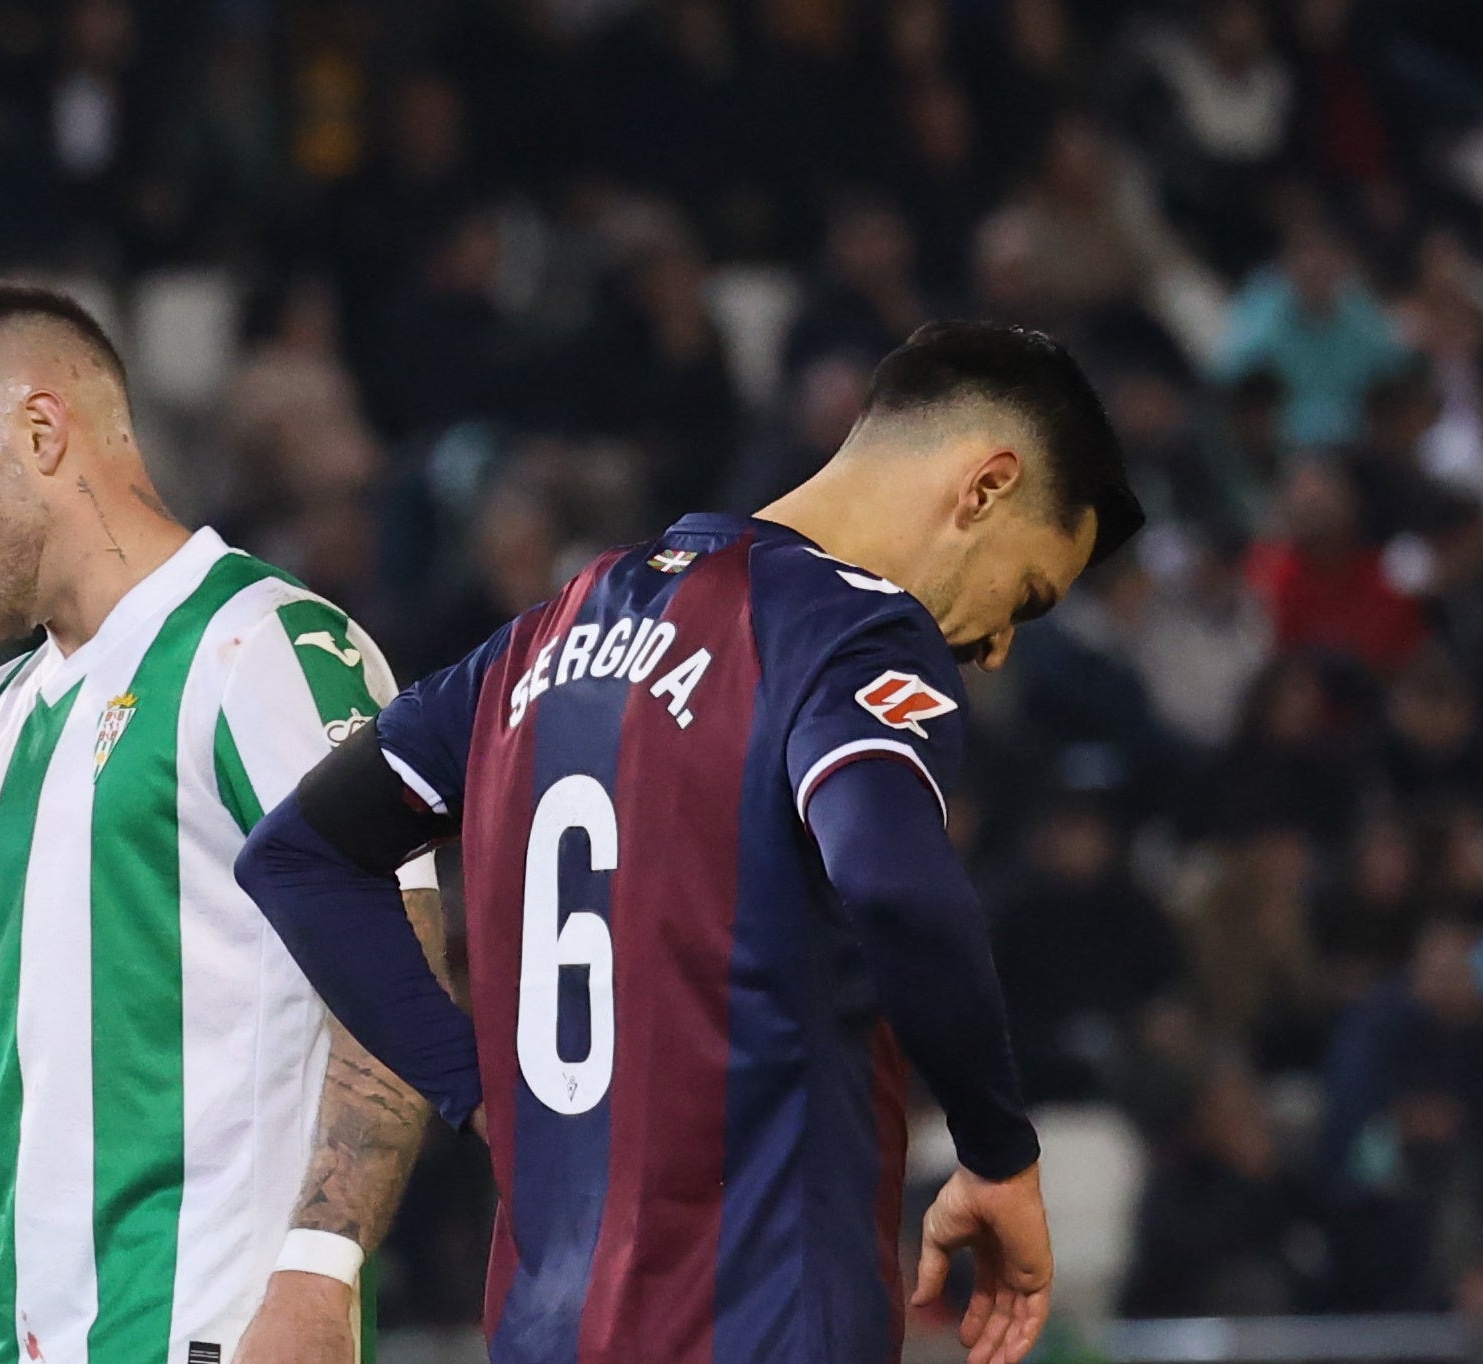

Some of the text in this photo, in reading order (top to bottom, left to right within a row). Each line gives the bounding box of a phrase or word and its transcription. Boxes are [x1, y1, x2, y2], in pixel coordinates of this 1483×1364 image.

[508, 616, 713, 730] SERGIO A.
[516, 773, 619, 1116] 6
